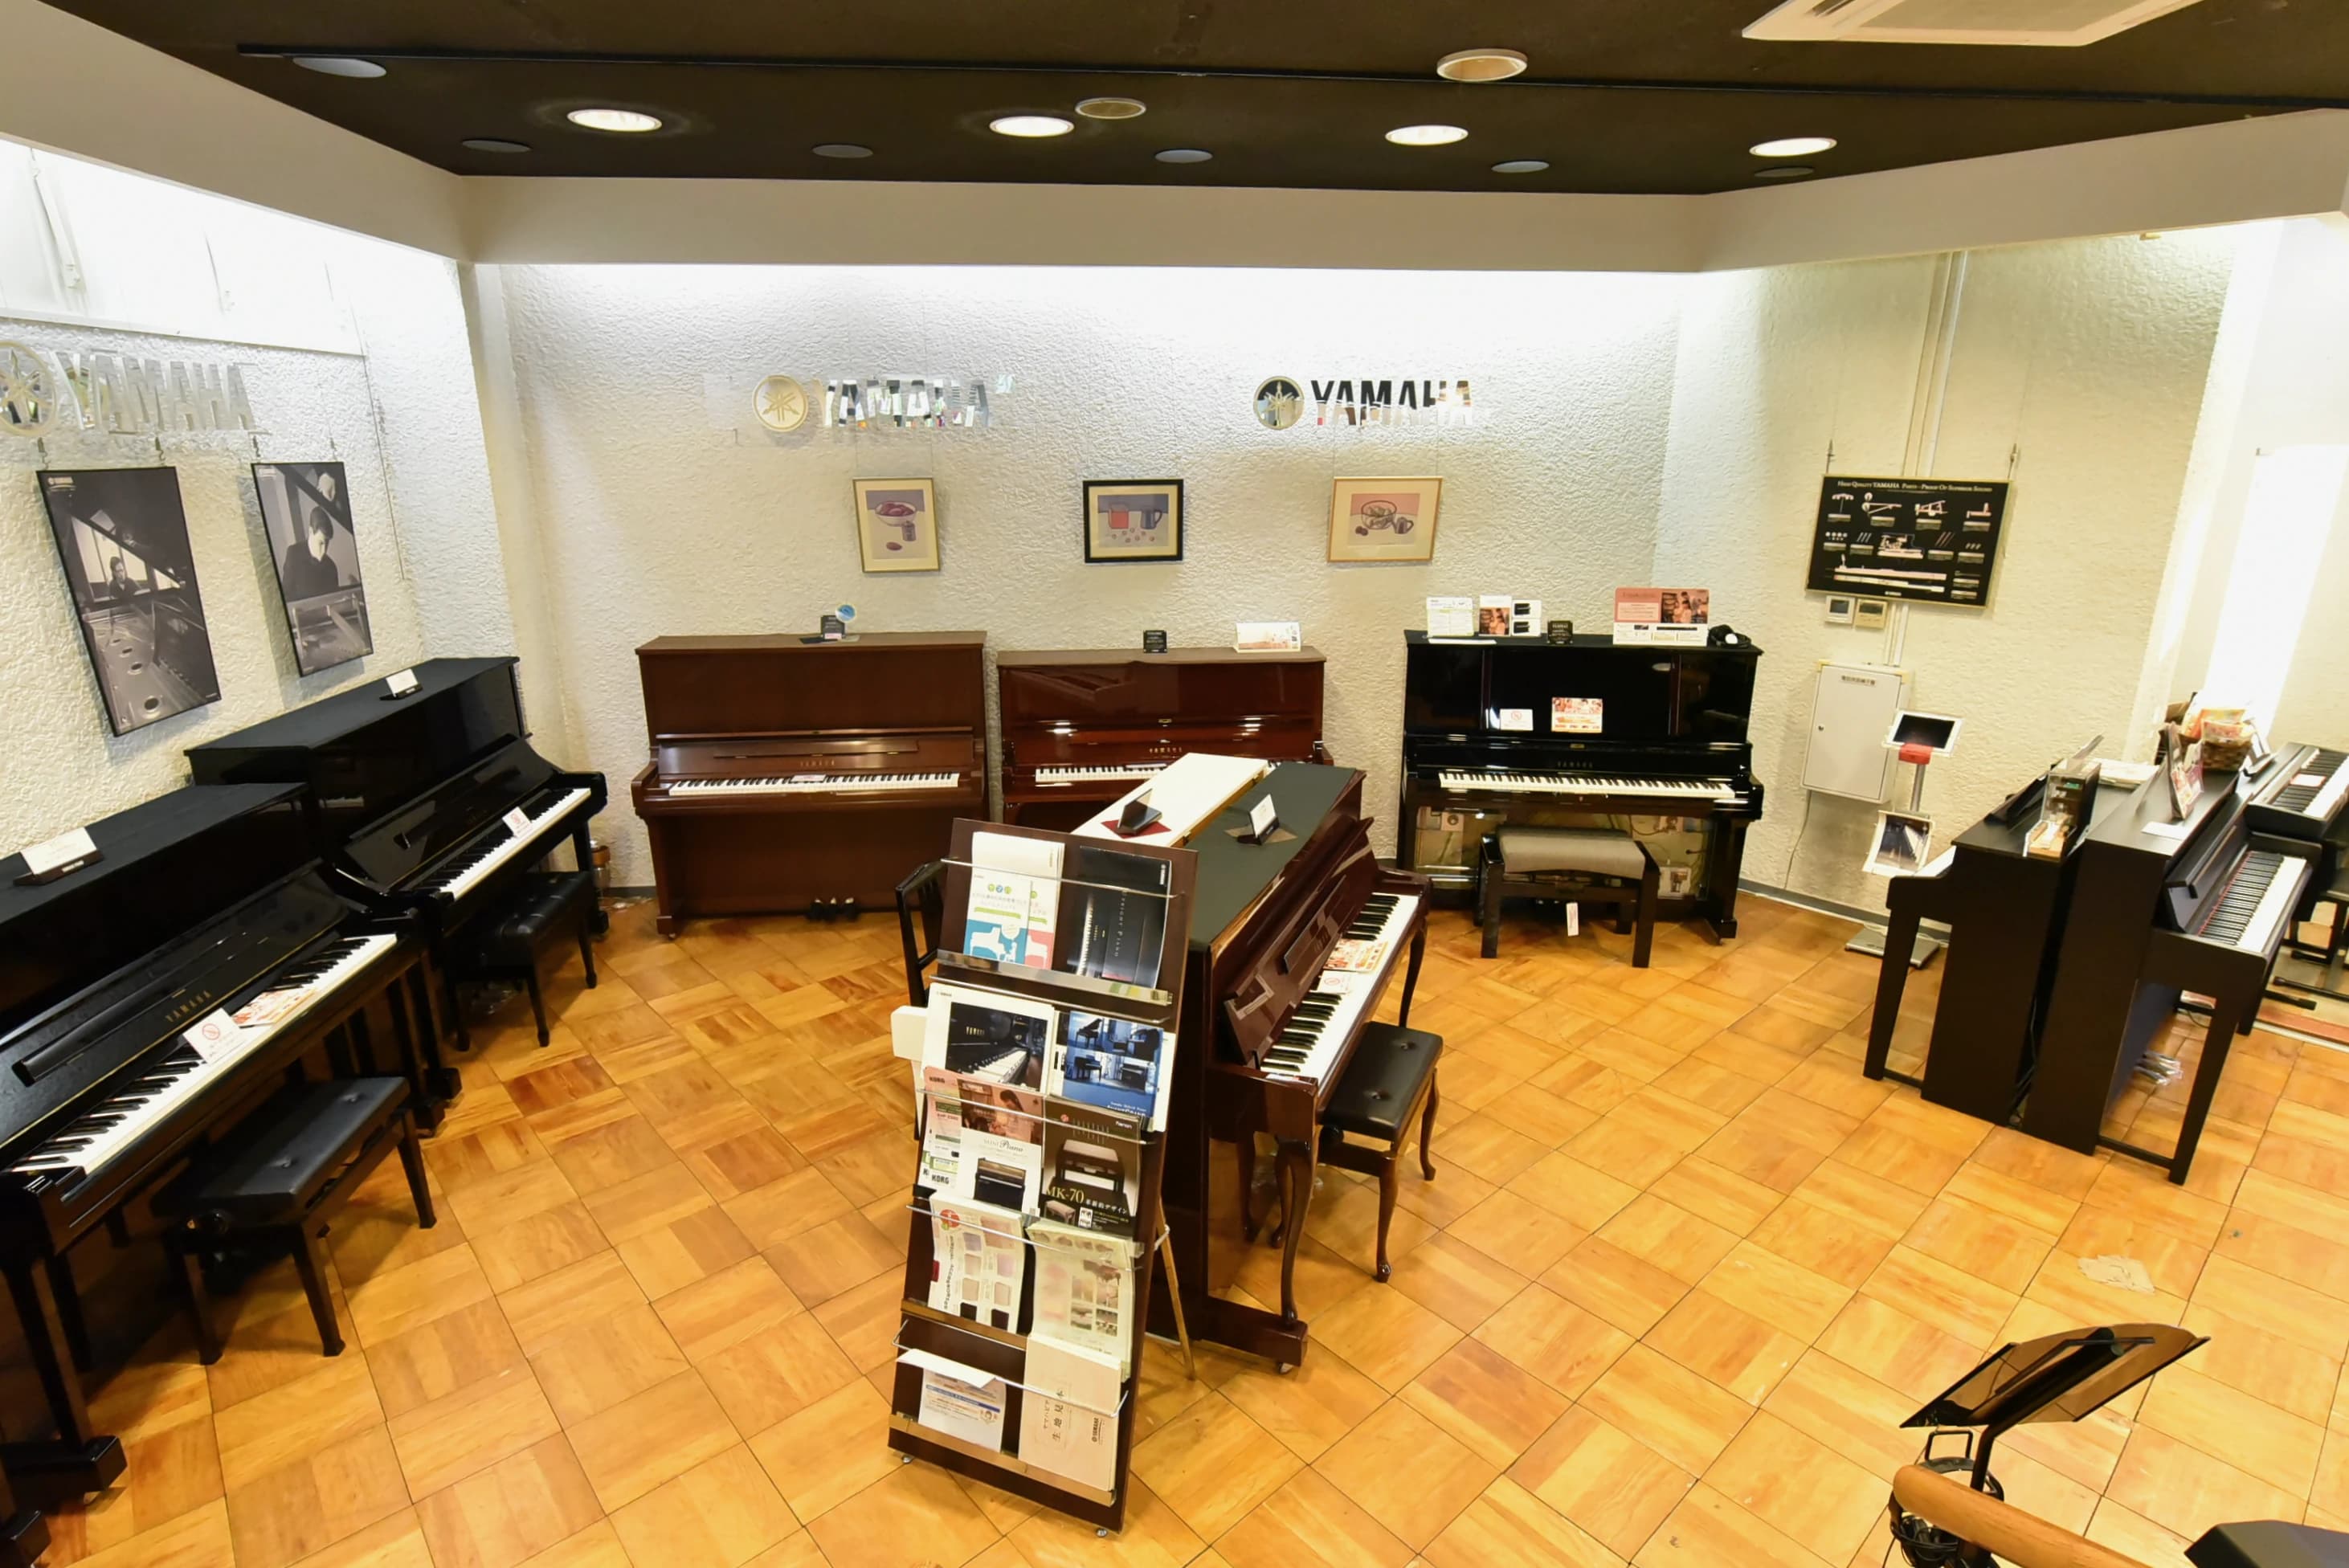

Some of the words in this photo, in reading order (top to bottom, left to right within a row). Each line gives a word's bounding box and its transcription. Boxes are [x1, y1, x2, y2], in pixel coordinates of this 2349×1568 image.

[50, 352, 256, 432] YAMAHA
[813, 379, 990, 427] YAMAHA
[1310, 380, 1473, 426] YAMAHA
[165, 990, 212, 1023] YAMAHA
[931, 1174, 950, 1185] KORG
[1046, 1185, 1085, 1204] MK-70
